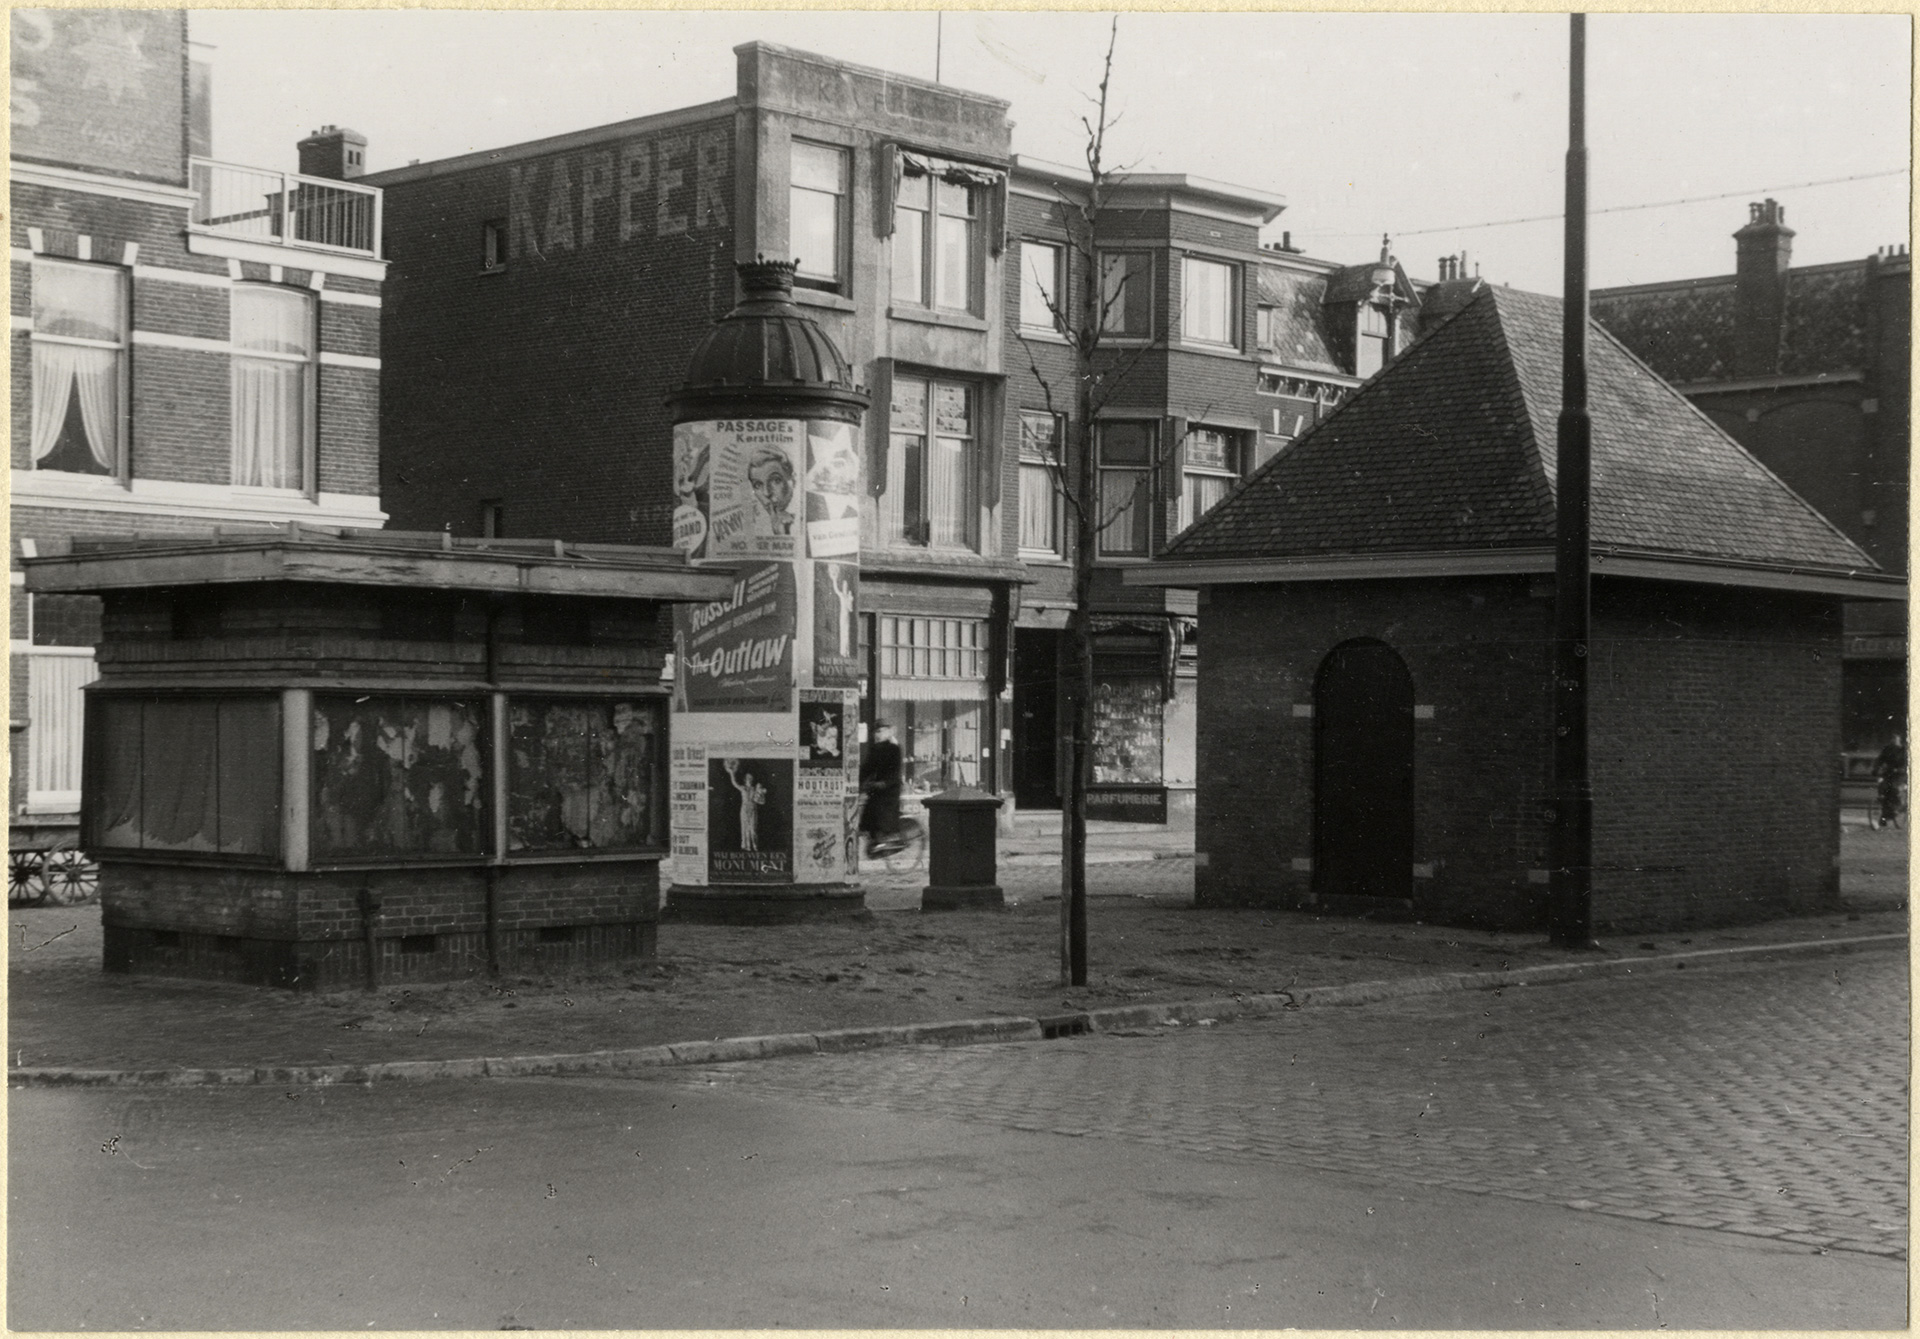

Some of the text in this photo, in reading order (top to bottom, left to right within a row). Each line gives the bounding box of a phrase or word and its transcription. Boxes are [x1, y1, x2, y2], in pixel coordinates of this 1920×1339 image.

[508, 130, 728, 260] KAPPER
[736, 434, 793, 444] Kerstfilm
[798, 781, 844, 790] HOUTRUST
[1086, 793, 1161, 805] PARFUMERIE
[729, 852, 767, 860] BOUWEN
[714, 860, 787, 873] MONUMENT
